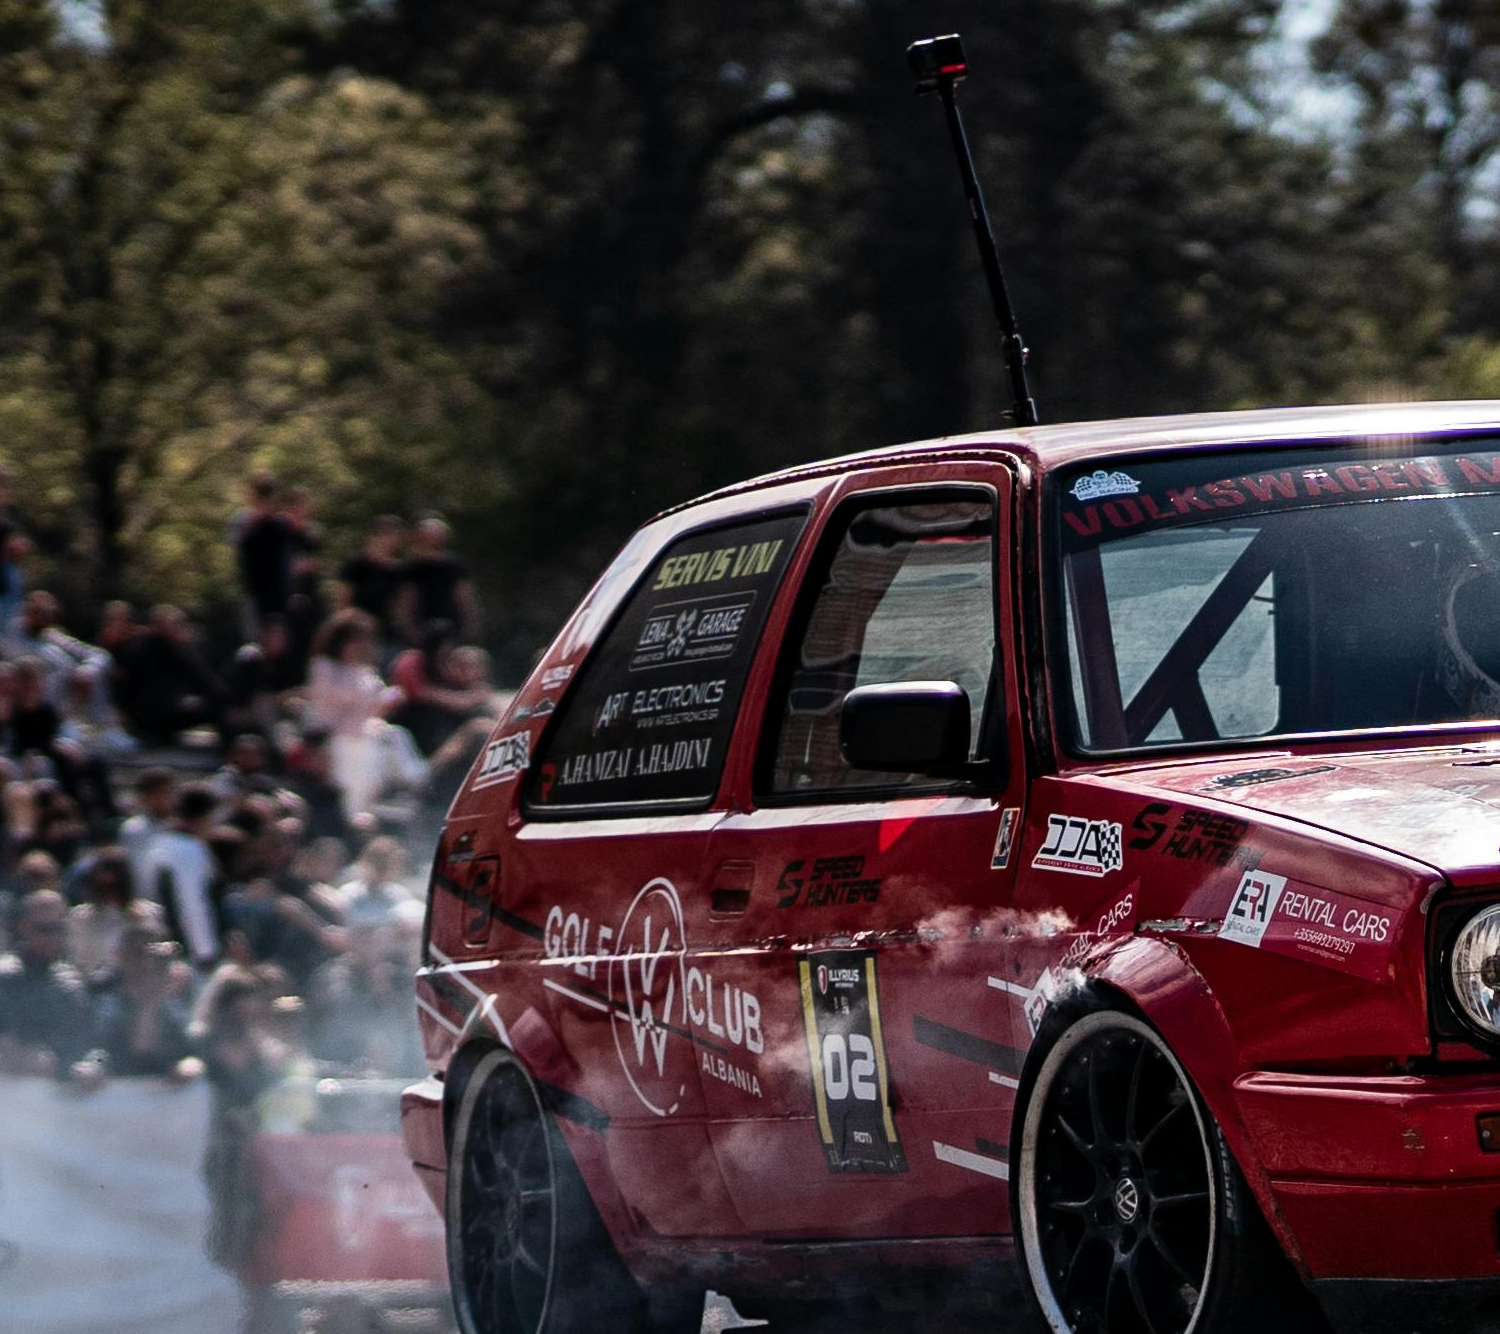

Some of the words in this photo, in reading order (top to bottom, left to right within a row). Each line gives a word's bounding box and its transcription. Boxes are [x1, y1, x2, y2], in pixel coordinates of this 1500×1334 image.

[1063, 460, 1449, 536] VOLKSWAGEN
[653, 547, 736, 590] SERVIS
[731, 539, 784, 578] VINI
[697, 609, 747, 636] GARAGE
[631, 680, 727, 714] ELECTRONICS
[1176, 810, 1249, 842] SPEED
[810, 855, 865, 881] SPEED
[804, 878, 883, 907] HUNTERS
[1097, 893, 1133, 937] CARS
[1279, 890, 1337, 928] RENTAL
[1343, 909, 1391, 942] CARS
[543, 905, 613, 981] GOLF
[686, 966, 764, 1054] CLUB
[702, 1051, 762, 1098] ALBANIA
[822, 1033, 877, 1102] 02
